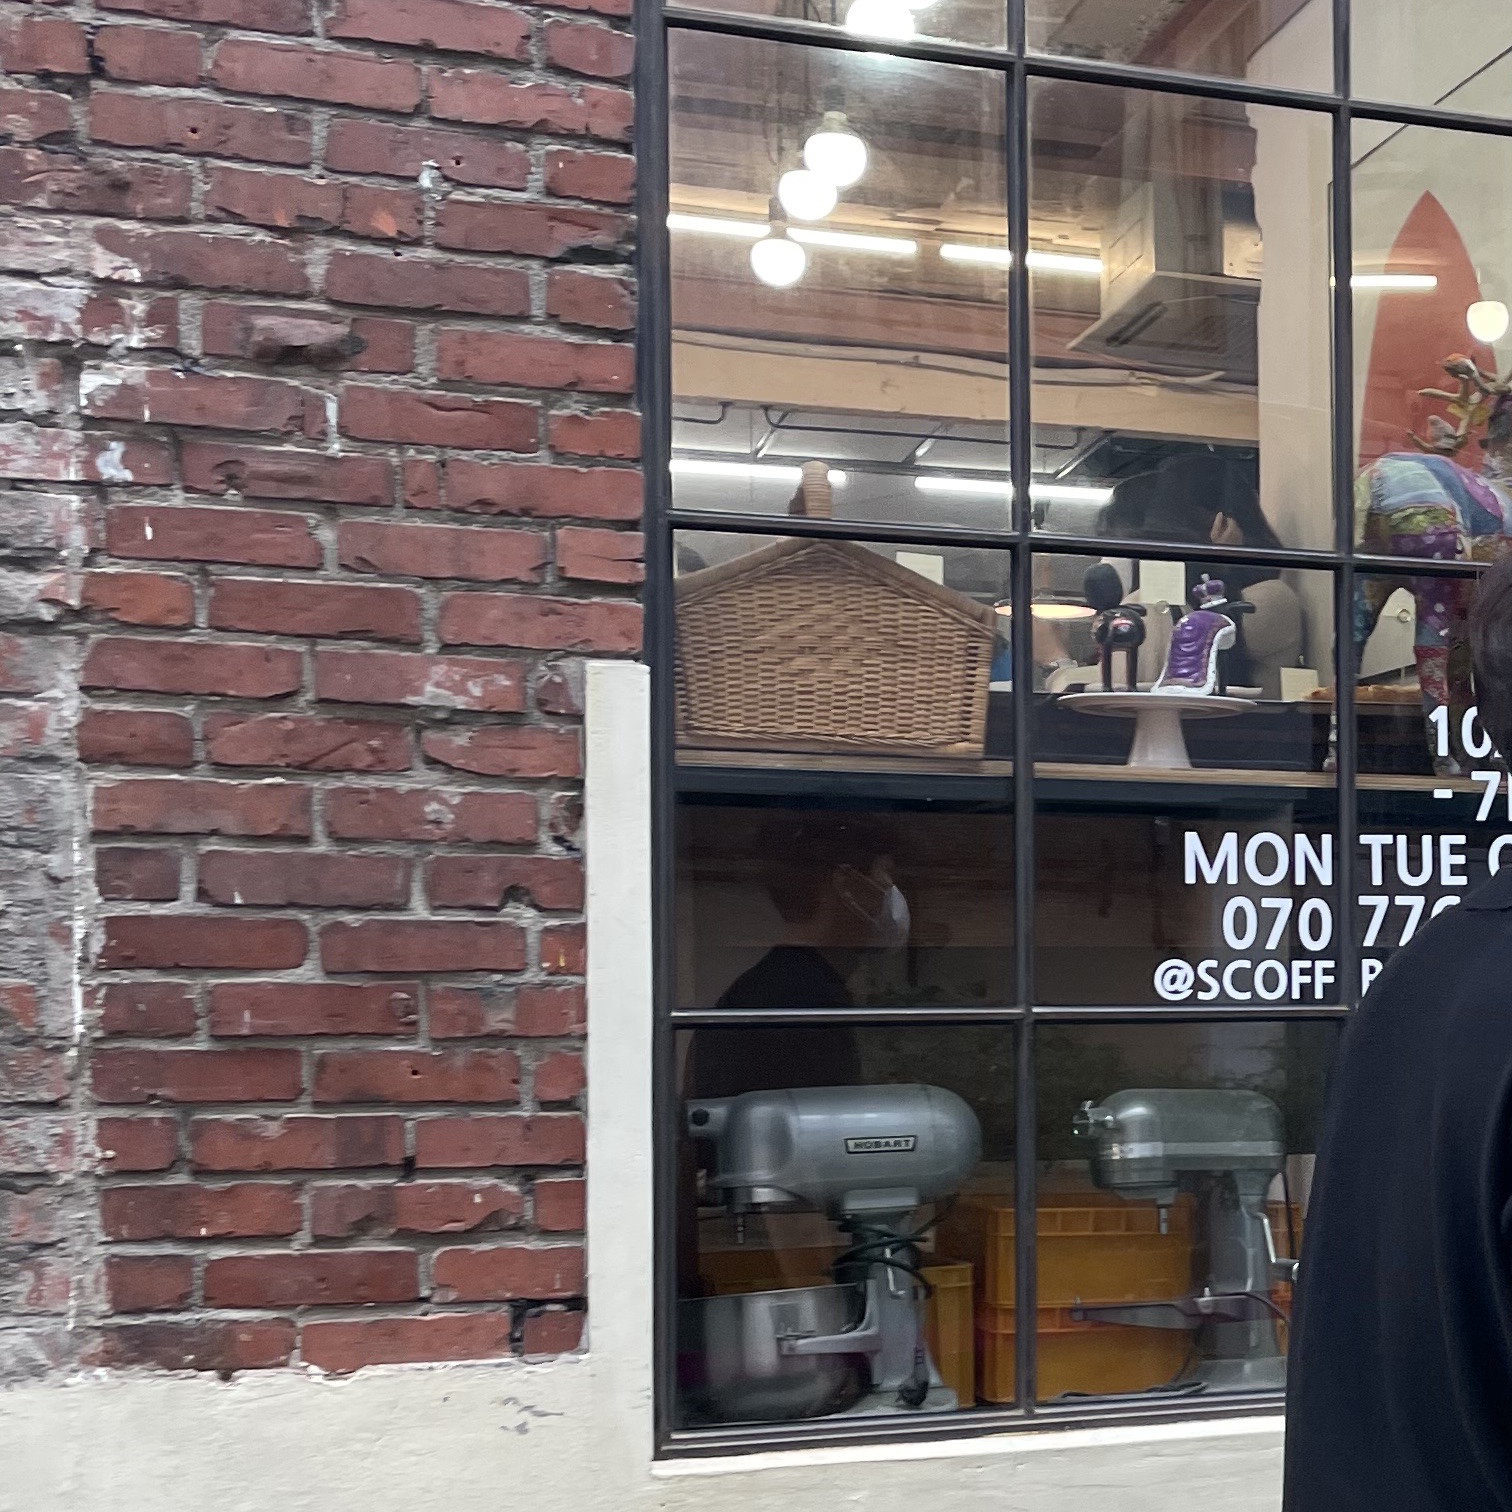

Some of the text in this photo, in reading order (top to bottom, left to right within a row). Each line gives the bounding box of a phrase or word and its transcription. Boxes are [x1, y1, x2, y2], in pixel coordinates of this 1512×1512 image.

[1428, 705, 1502, 758] 10
[1184, 831, 1333, 886] MON
[1358, 834, 1468, 886] TUE
[1222, 895, 1333, 951] 070
[1153, 958, 1336, 1001] @SCOFF
[853, 1139, 911, 1150] HOBART
